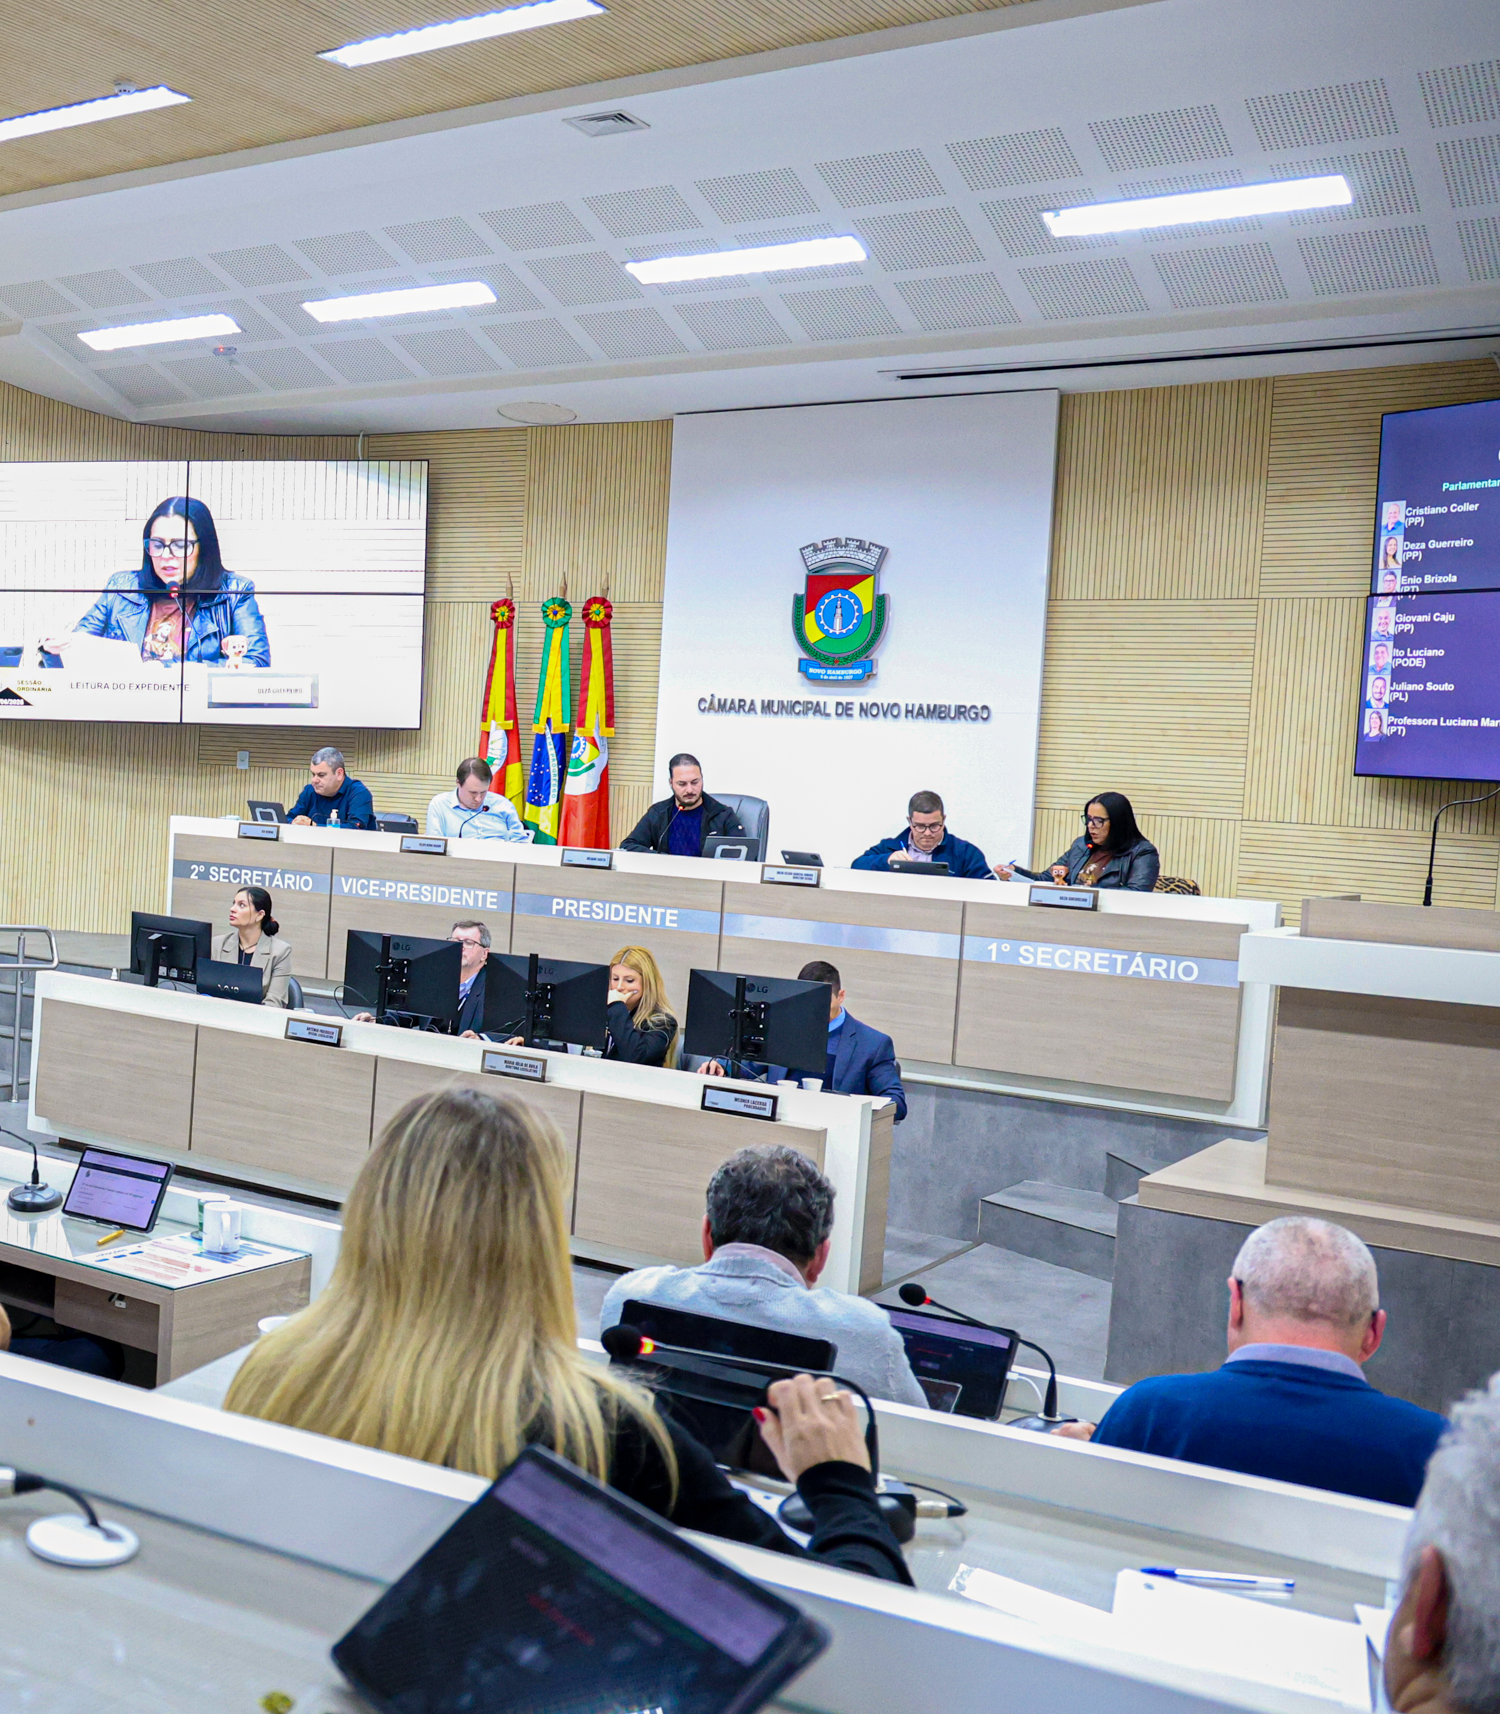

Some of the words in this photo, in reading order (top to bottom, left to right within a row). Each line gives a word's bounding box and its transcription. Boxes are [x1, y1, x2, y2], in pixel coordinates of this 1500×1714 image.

[1405, 506, 1448, 516] Cristiano
[1450, 502, 1479, 513] Coller
[1405, 517, 1425, 528] (PP)
[1403, 541, 1426, 551] Deza
[1428, 538, 1474, 549] Guerreiro
[1402, 551, 1422, 562] (PP)
[1401, 575, 1422, 585] Enio
[1424, 573, 1457, 584] Brizola
[1395, 613, 1431, 623] Giovani
[1433, 612, 1455, 624] Caju
[1394, 624, 1414, 635] (PP)
[1393, 648, 1405, 657] Ito
[1407, 648, 1444, 657] Luciano
[1392, 658, 1426, 668] (PODE)
[70, 682, 110, 690] LEITURA
[112, 682, 126, 690] DO
[128, 683, 190, 691] EXPEDIENTE
[1390, 682, 1424, 691] Juliano
[1426, 682, 1455, 691] Souto
[1389, 692, 1409, 702] (PL)
[698, 694, 758, 715] CÂMARA
[761, 699, 831, 717] MUNICIPAL
[835, 701, 854, 718] DE
[859, 702, 900, 719] NOVO
[904, 703, 991, 721] HAMBURGO
[1388, 716, 1438, 726] Professora
[1440, 717, 1478, 727] Luciana
[1387, 726, 1406, 736] (PT)
[550, 753, 558, 799] PROGRESSO
[209, 865, 313, 892] SECRETÁRIO
[341, 877, 498, 909] VICE-PRESIDENTE
[552, 897, 678, 928] PRESIDENTE
[1019, 945, 1199, 981] SECRETÁRIO
